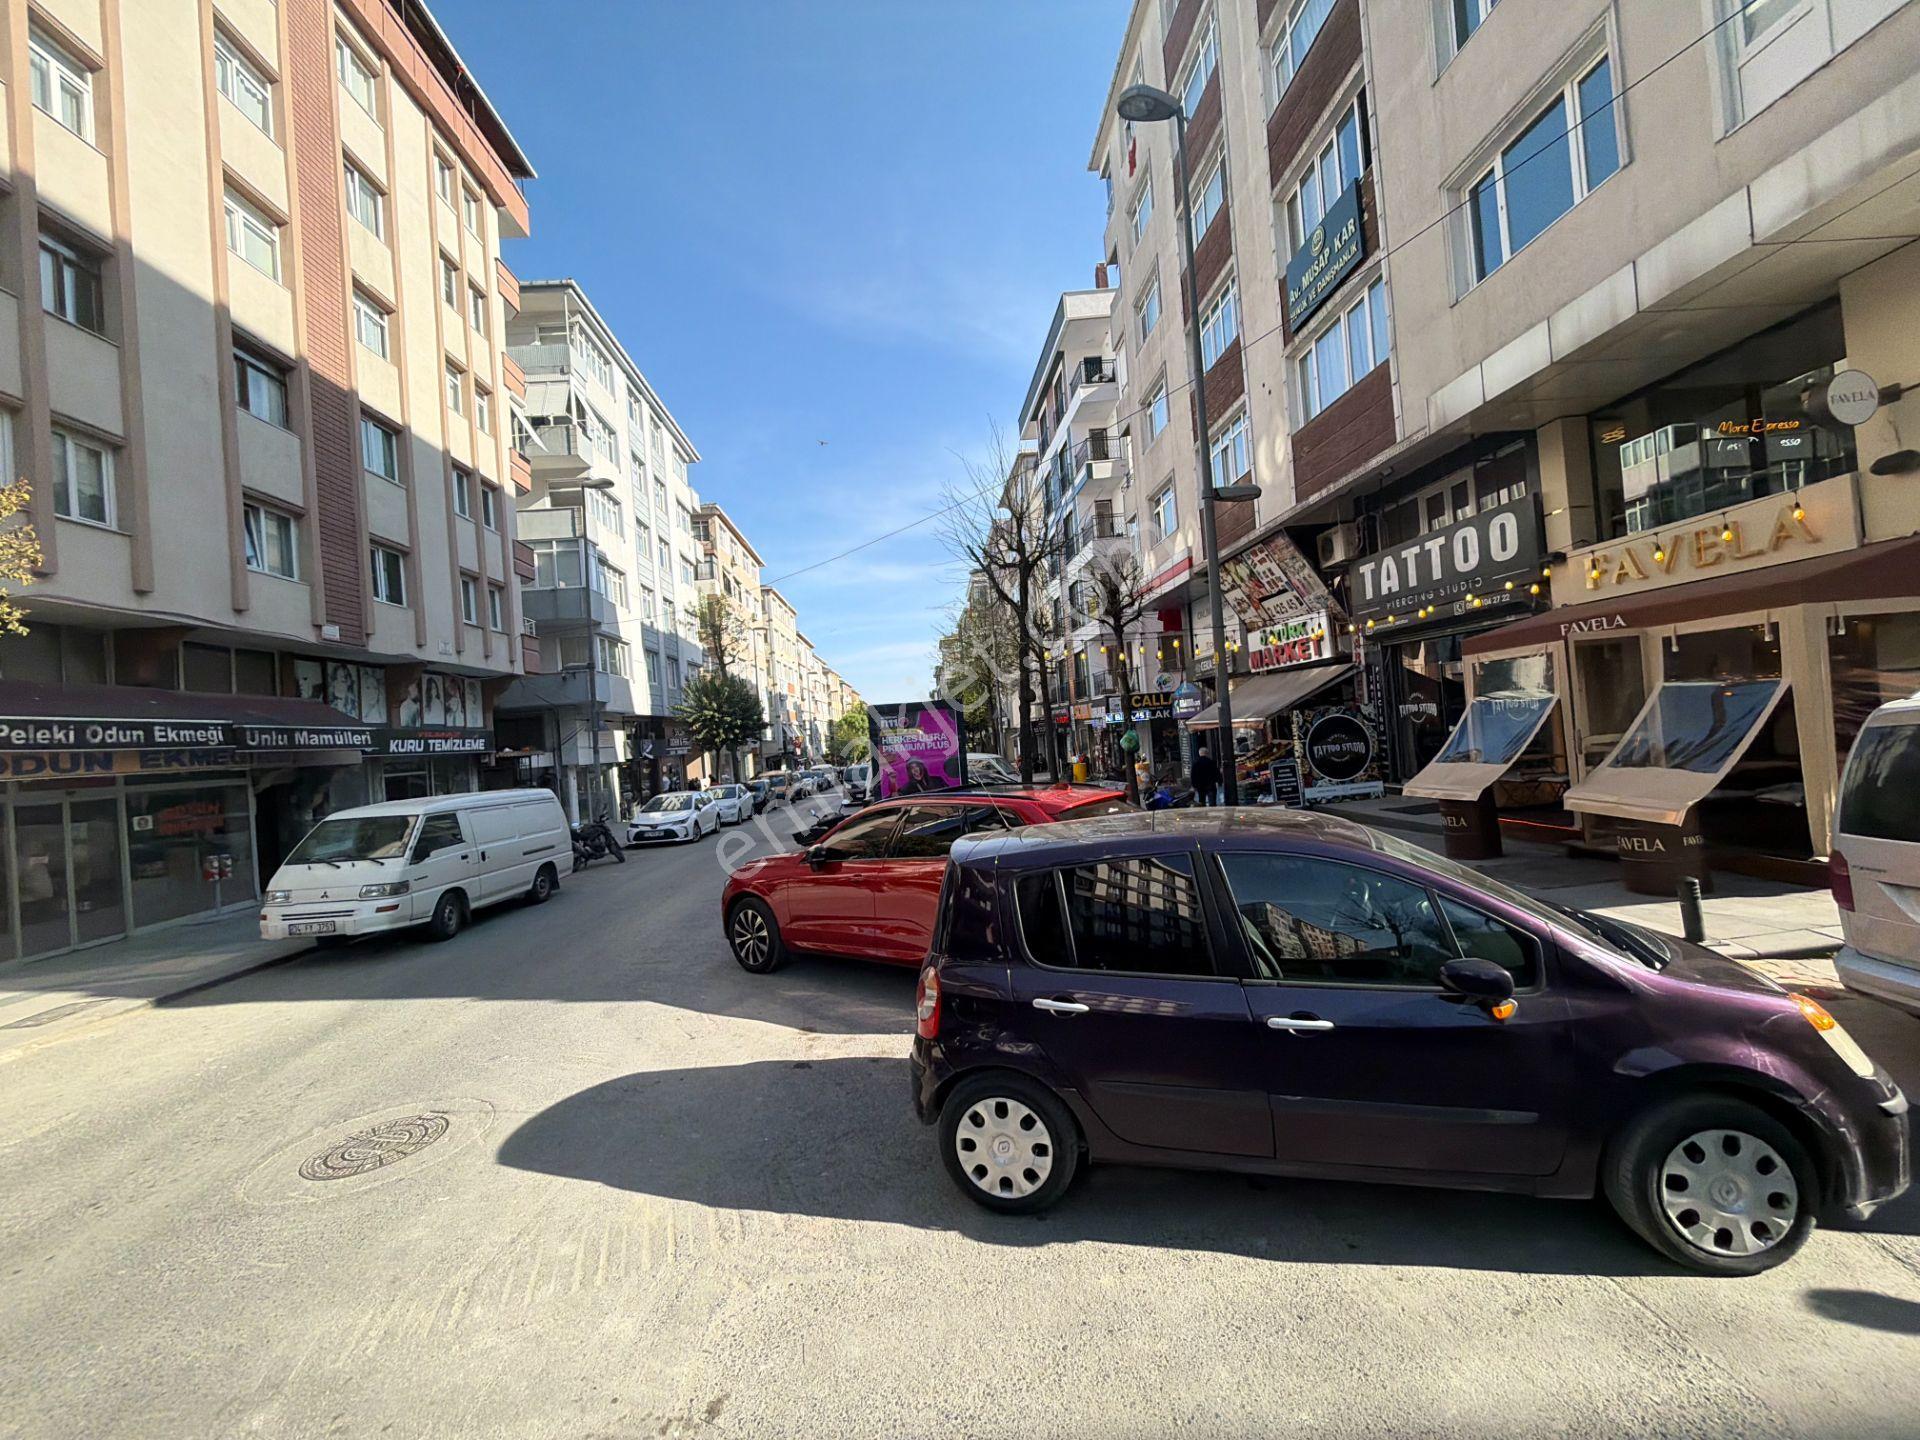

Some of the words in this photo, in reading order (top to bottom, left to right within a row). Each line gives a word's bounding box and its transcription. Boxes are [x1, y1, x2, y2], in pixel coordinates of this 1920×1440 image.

[1302, 247, 1330, 288] MUSAP
[1333, 219, 1356, 252] KAR
[1717, 420, 1749, 434] More
[1359, 512, 1519, 600] TATTOO
[1584, 504, 1822, 591] FAVELA
[1386, 590, 1435, 610] PIERCING
[1439, 577, 1483, 597] STUDIO
[1560, 614, 1627, 636] FAVELA
[1250, 638, 1324, 671] MARKET
[86, 726, 145, 744] Odun
[154, 726, 224, 745] Ekmeği
[294, 730, 372, 745] Mamülleri
[389, 739, 424, 753] KURU
[428, 737, 486, 751] TEMİZLEME
[882, 735, 918, 744] HERKES
[882, 743, 926, 753] PREMIUM
[927, 740, 950, 750] PLUS
[1312, 743, 1340, 759] TATTOO
[1341, 741, 1366, 754] STUDIO
[0, 751, 114, 776] DUN
